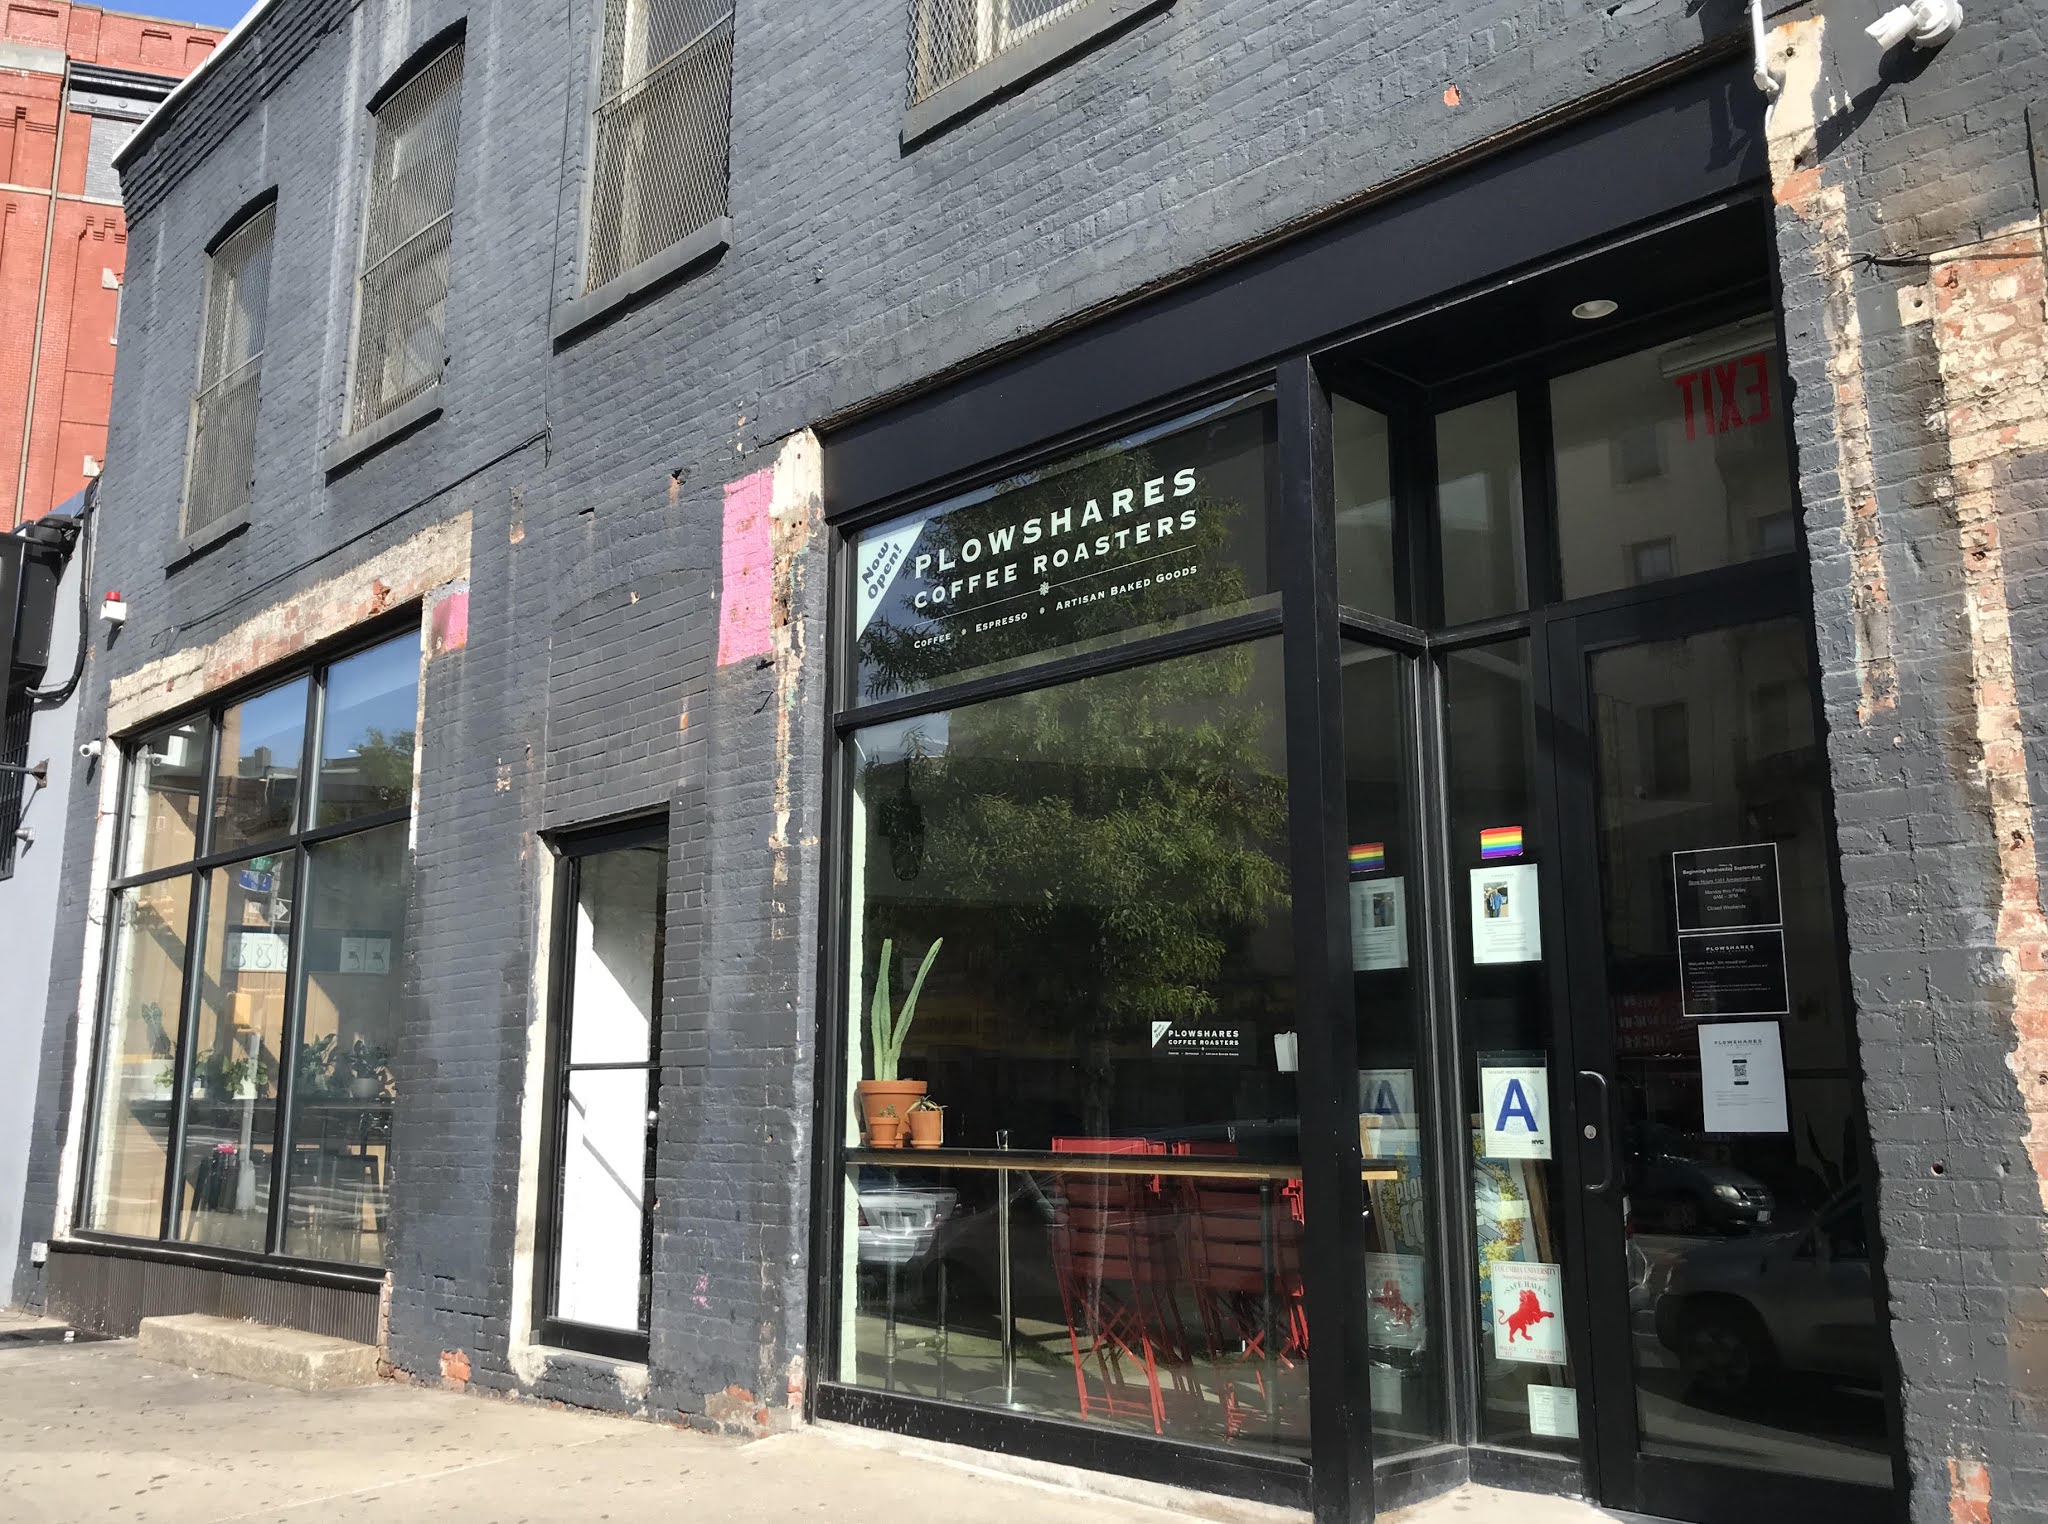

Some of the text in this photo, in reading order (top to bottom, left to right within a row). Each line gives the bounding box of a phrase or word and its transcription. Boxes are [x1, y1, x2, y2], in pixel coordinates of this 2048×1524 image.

[914, 467, 1197, 579] PLOWSHARES
[862, 541, 889, 584] Now
[868, 543, 902, 599] Open!
[913, 509, 1197, 609] COFFEE ROASTERS
[913, 565, 1197, 649] COFFEE ESPRESSO ARTISAN BAKED GOODS
[1495, 1079, 1538, 1132] A
[1523, 1266, 1556, 1275] UNIVERSITY
